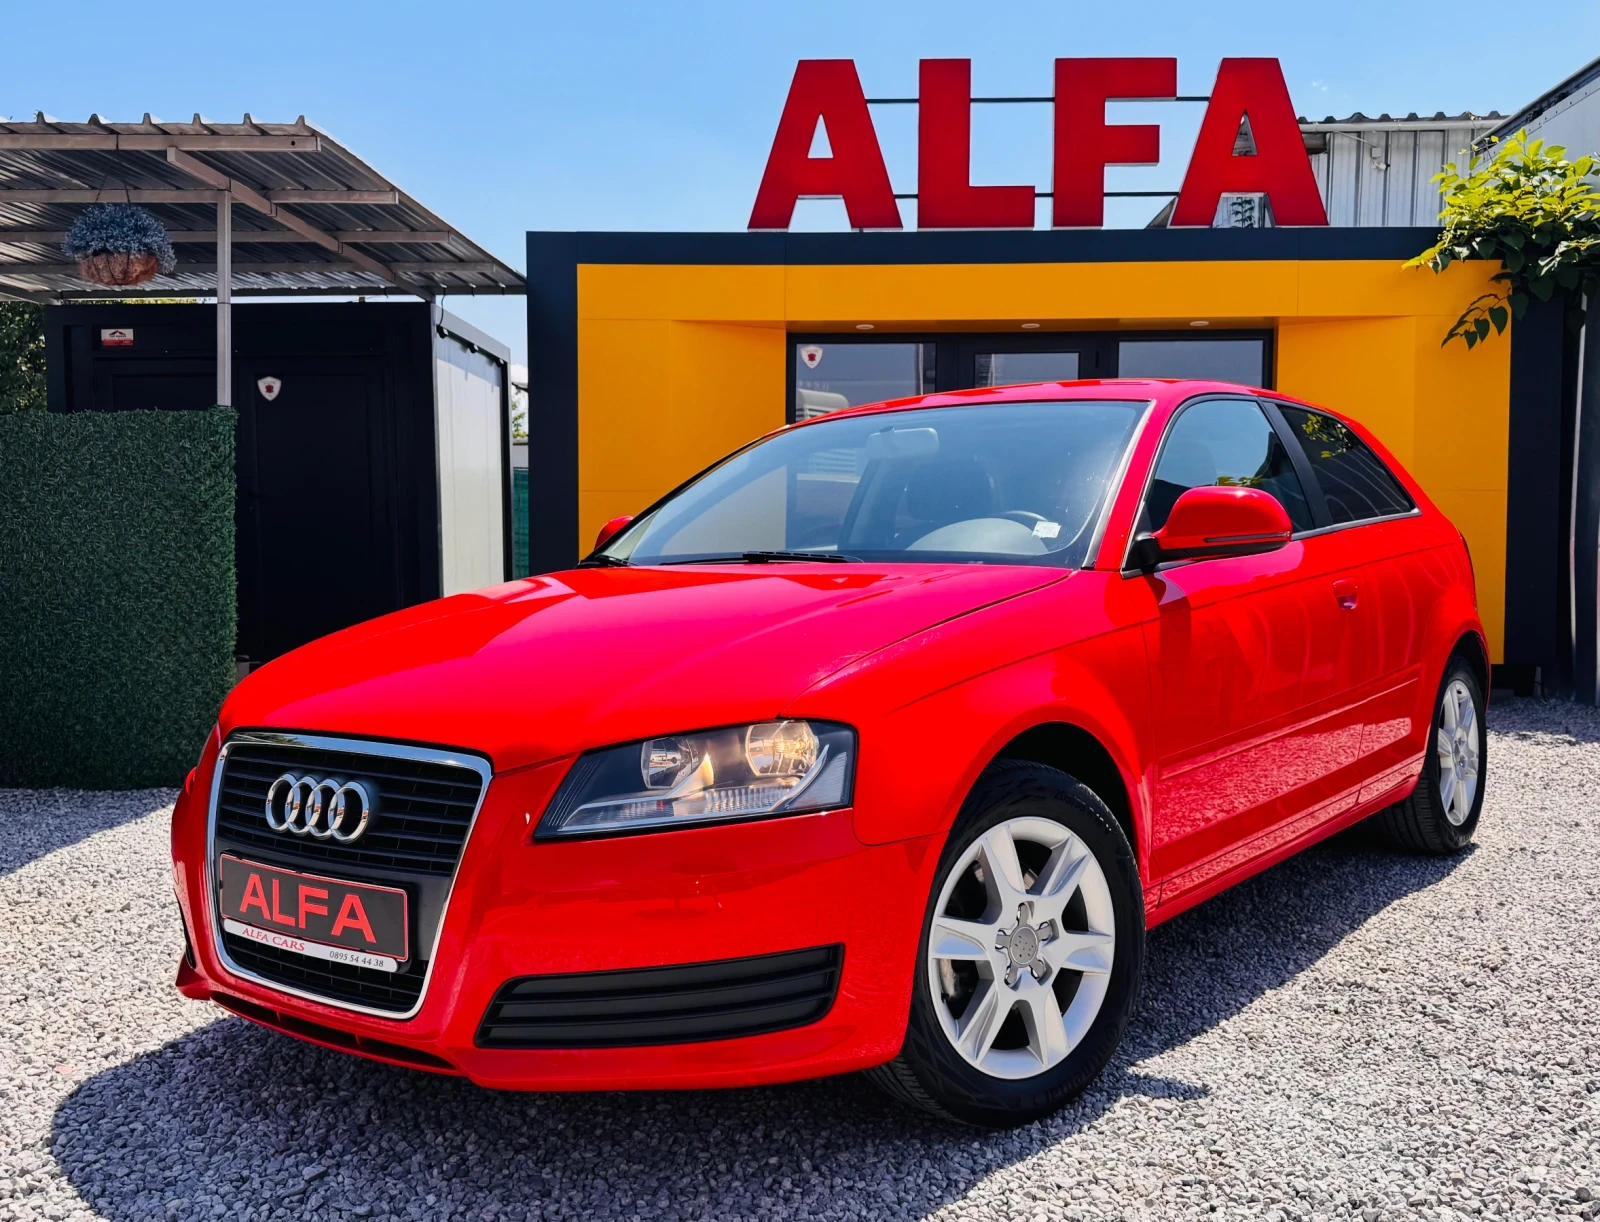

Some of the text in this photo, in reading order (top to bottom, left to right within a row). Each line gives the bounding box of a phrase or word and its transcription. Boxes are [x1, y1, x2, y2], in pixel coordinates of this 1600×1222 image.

[747, 58, 1330, 230] ALFA
[239, 873, 377, 943] ALFA
[242, 927, 305, 952] ALFA CARS
[329, 950, 384, 968] 0895 54 44 38
